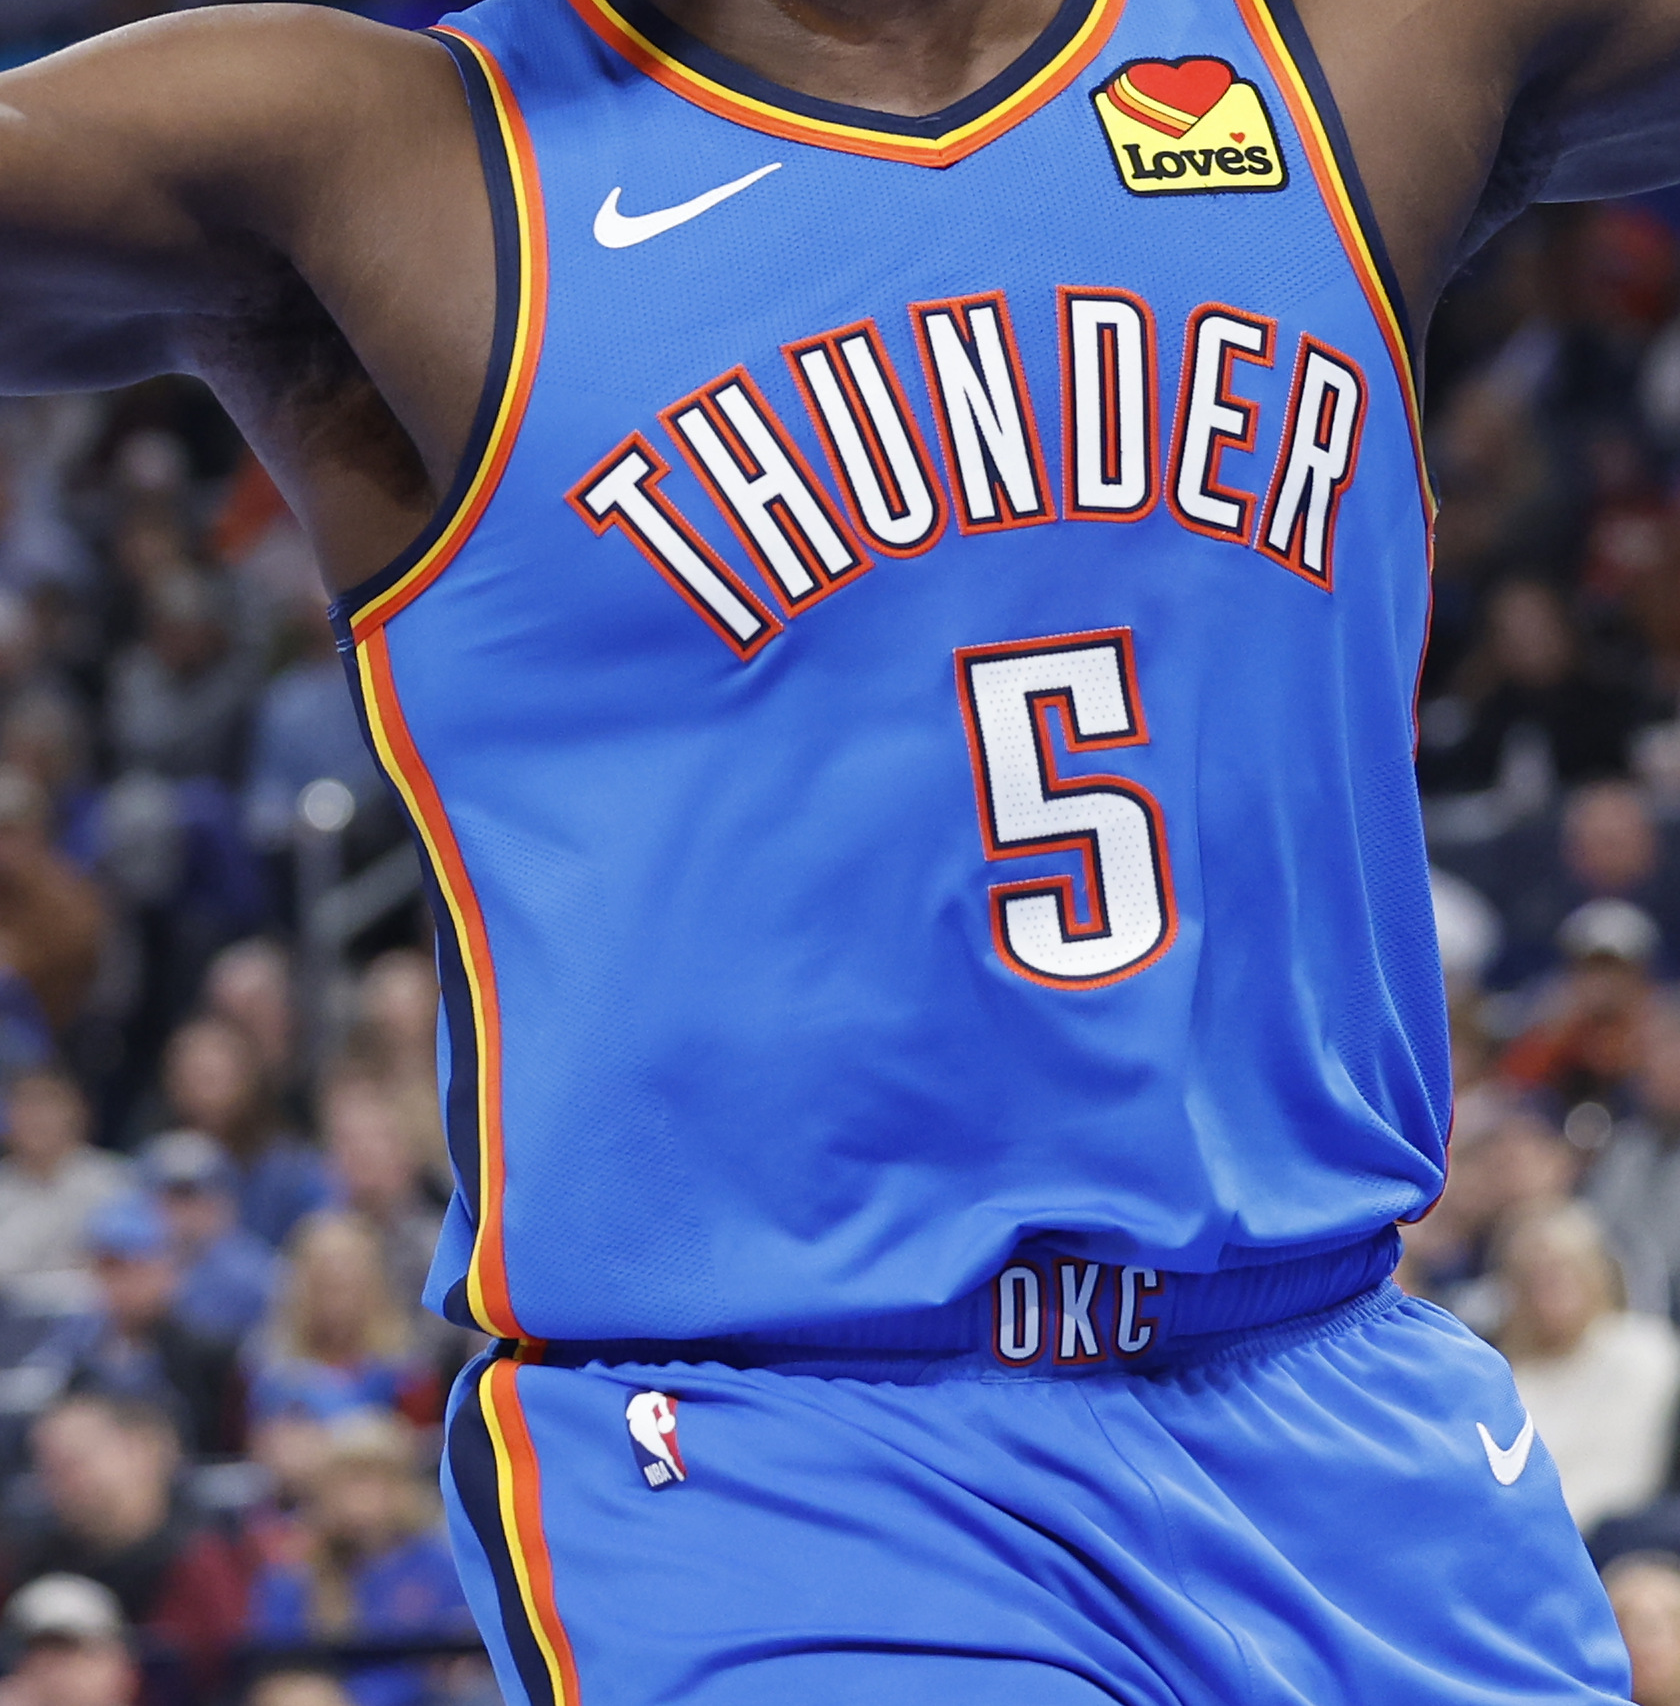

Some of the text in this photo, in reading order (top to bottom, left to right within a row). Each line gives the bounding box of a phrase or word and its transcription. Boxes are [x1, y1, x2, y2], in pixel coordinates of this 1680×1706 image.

[563, 284, 1368, 662] THUNDER
[952, 625, 1180, 991] 5
[992, 1256, 1165, 1368] OKC
[643, 1460, 672, 1487] NBA
